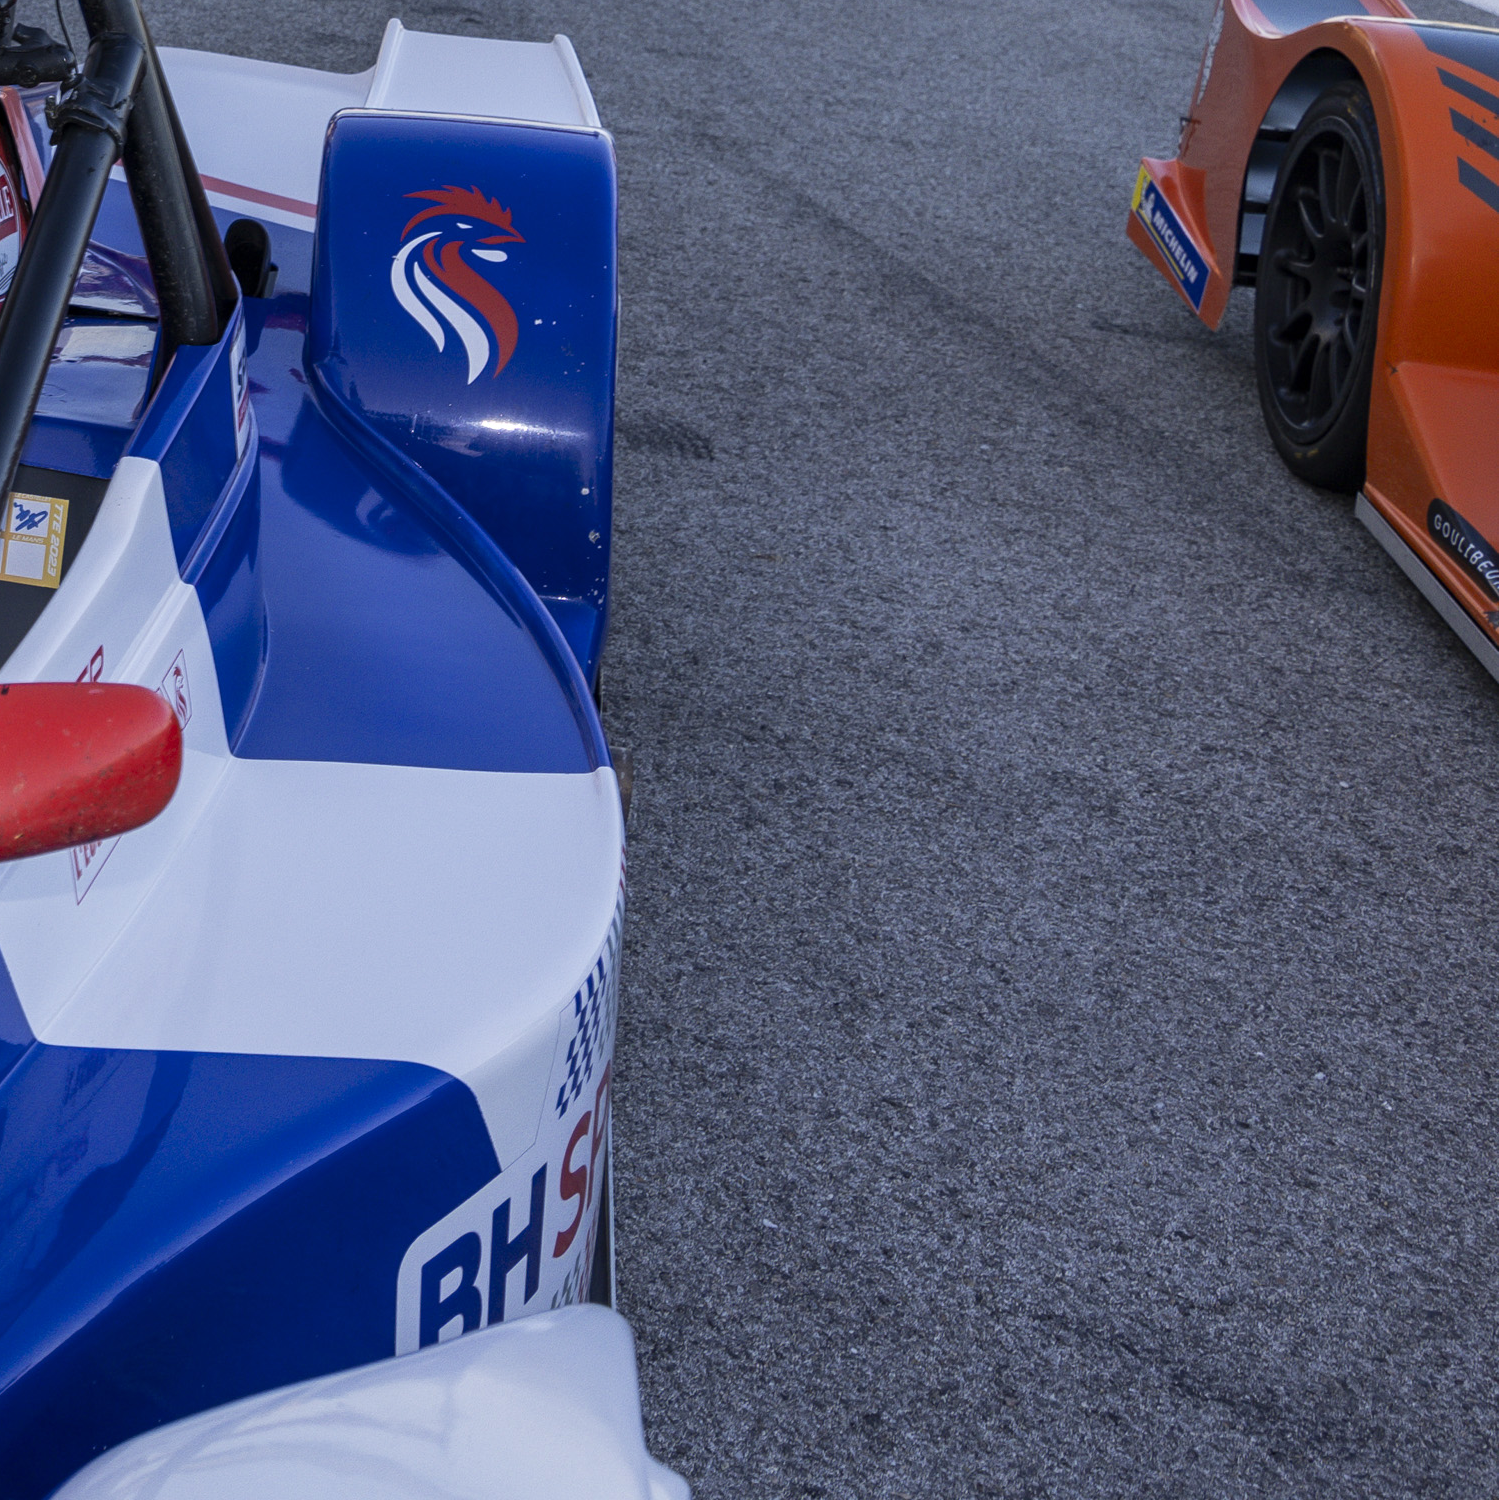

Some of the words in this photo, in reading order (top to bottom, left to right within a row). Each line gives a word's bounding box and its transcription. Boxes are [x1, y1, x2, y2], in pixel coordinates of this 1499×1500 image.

[1152, 212, 1197, 285] MICHELIN
[22, 536, 44, 544] MANS
[52, 503, 64, 534] TTE
[48, 534, 60, 577] 2023
[418, 1162, 548, 1351] BH
